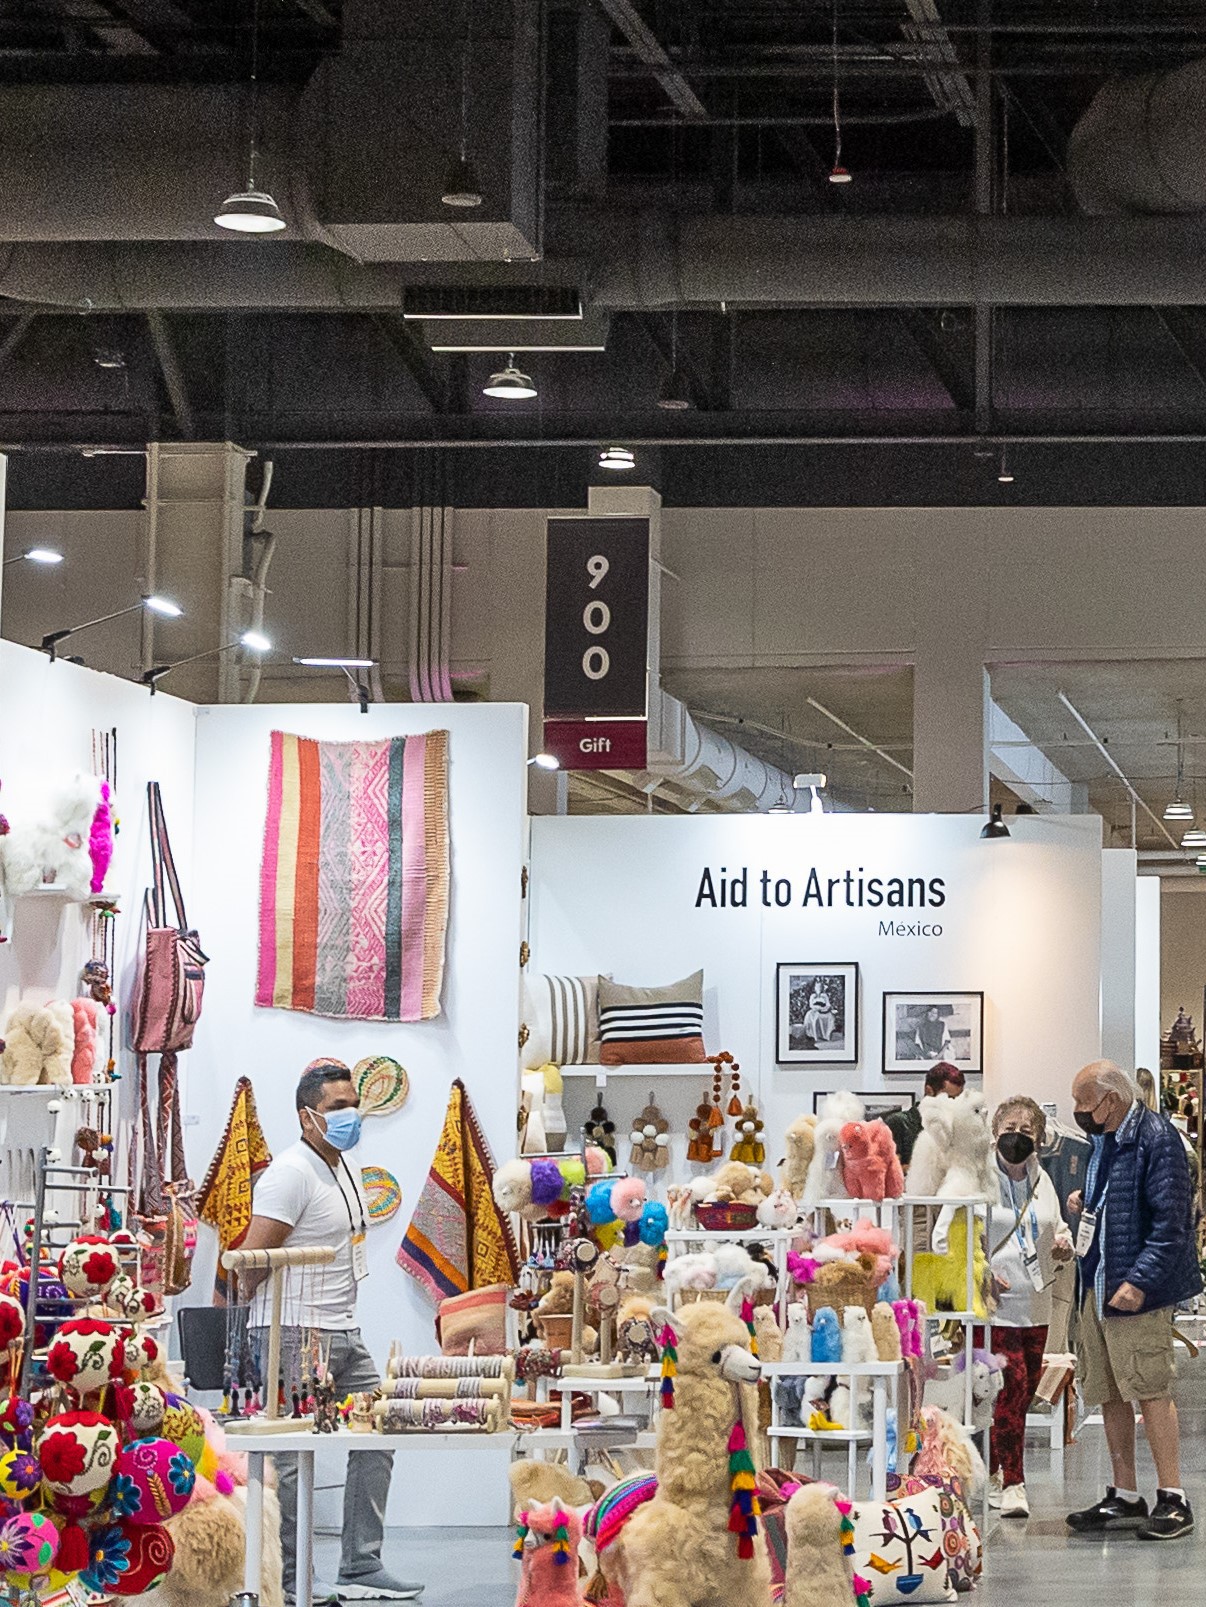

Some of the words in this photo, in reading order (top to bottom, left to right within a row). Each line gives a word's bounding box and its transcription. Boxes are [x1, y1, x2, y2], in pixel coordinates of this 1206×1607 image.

[583, 555, 610, 679] 900
[580, 738, 610, 752] Gift
[696, 868, 747, 907] Aid
[760, 870, 791, 906] to
[803, 868, 945, 907] Artisans
[879, 921, 942, 936] México
